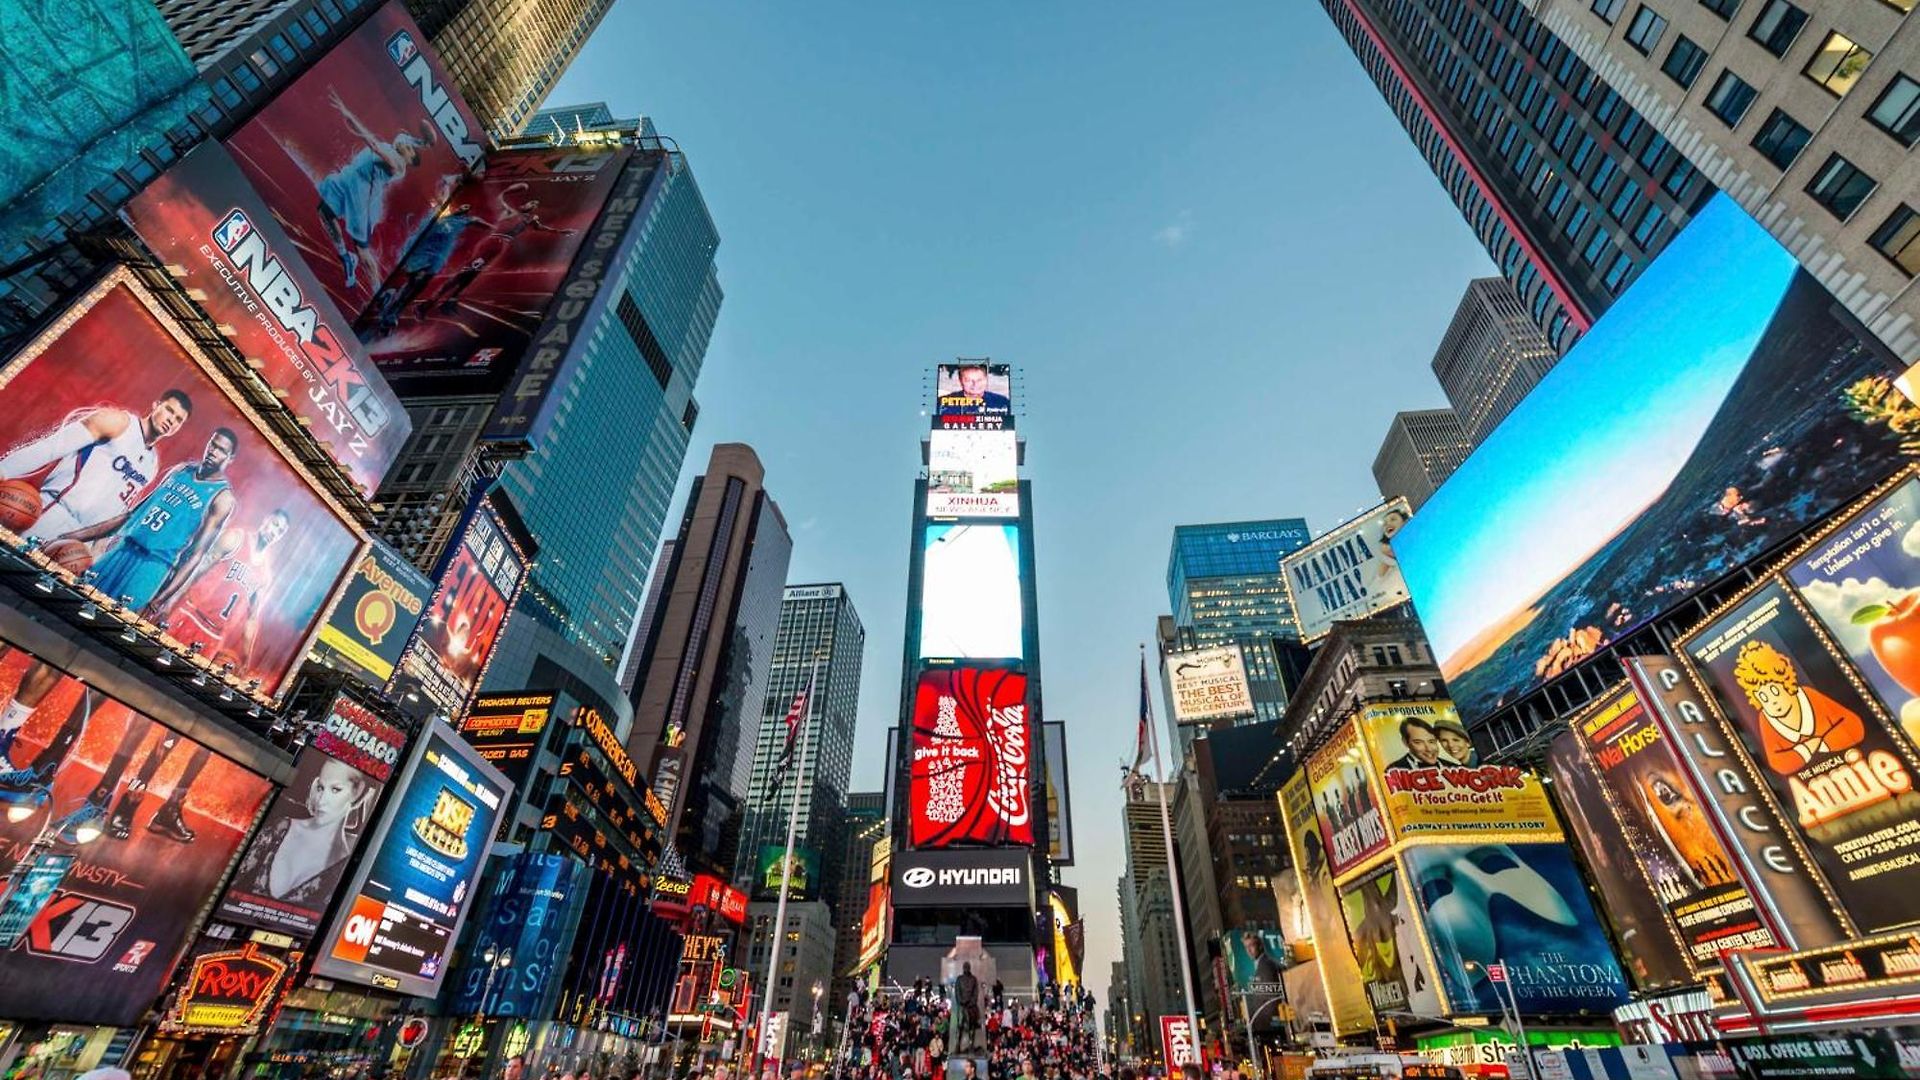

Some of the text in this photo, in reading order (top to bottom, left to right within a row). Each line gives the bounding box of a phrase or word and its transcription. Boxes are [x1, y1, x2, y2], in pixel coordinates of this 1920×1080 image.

[400, 52, 487, 178] NBA
[594, 166, 655, 249] TIMES
[199, 245, 317, 385] EXECUTIVE PRODUCED BY
[513, 259, 605, 398] SQUARE
[941, 397, 987, 407] PETER P.
[308, 383, 369, 458] JAY Z
[943, 422, 1003, 430] GALLERY
[947, 497, 999, 507] XINHUA
[141, 504, 171, 532] 35
[1241, 529, 1303, 541] BARCLAYS
[1807, 535, 1853, 570] Temptation
[1850, 522, 1872, 540] isn't
[1871, 518, 1881, 526] a
[1823, 520, 1907, 576] Unless you give in.
[1292, 533, 1374, 594] MAMMA
[356, 554, 423, 616] Avenue
[788, 587, 820, 598] Allianz
[1316, 567, 1368, 615] MIA!
[219, 592, 239, 619] 1
[354, 589, 397, 646] Q
[1179, 682, 1242, 700] THE BEST
[1200, 675, 1240, 686] MUSICAL
[477, 695, 553, 708] THOMSON REUTERS
[1180, 692, 1245, 708] MUSICAL OF
[1202, 700, 1245, 711] CENTURY
[325, 713, 398, 765] CHICAGO
[585, 708, 627, 770] CONFERENCE
[1596, 746, 1625, 771] War
[1618, 722, 1661, 758] Horse
[509, 749, 530, 759] GAS
[914, 745, 980, 761] give it back
[1312, 761, 1335, 783] GOES
[1384, 765, 1525, 795] NICE WORK
[1659, 667, 1795, 875] PALACE
[1797, 755, 1845, 781] THE MUSICAL
[1412, 791, 1504, 805] If You Can Get It
[1788, 747, 1913, 830] Annie
[1452, 822, 1492, 831] FUNNIEST
[1493, 822, 1517, 830] LOVE
[1518, 821, 1546, 830] STORY
[68, 859, 128, 887] NASTY
[655, 875, 691, 894] Reese's
[938, 868, 1021, 886] HYUNDAI
[1539, 951, 1567, 964] THE
[1690, 939, 1719, 957] LINCOLN
[1717, 933, 1744, 950] CENTER
[1507, 963, 1623, 985] PHANTOM
[1820, 950, 1868, 985] Annie
[1516, 984, 1617, 999] OF THE OPERA
[1168, 1020, 1190, 1067] tkts
[1741, 1038, 1854, 1061] BOX OFFICE HERE
